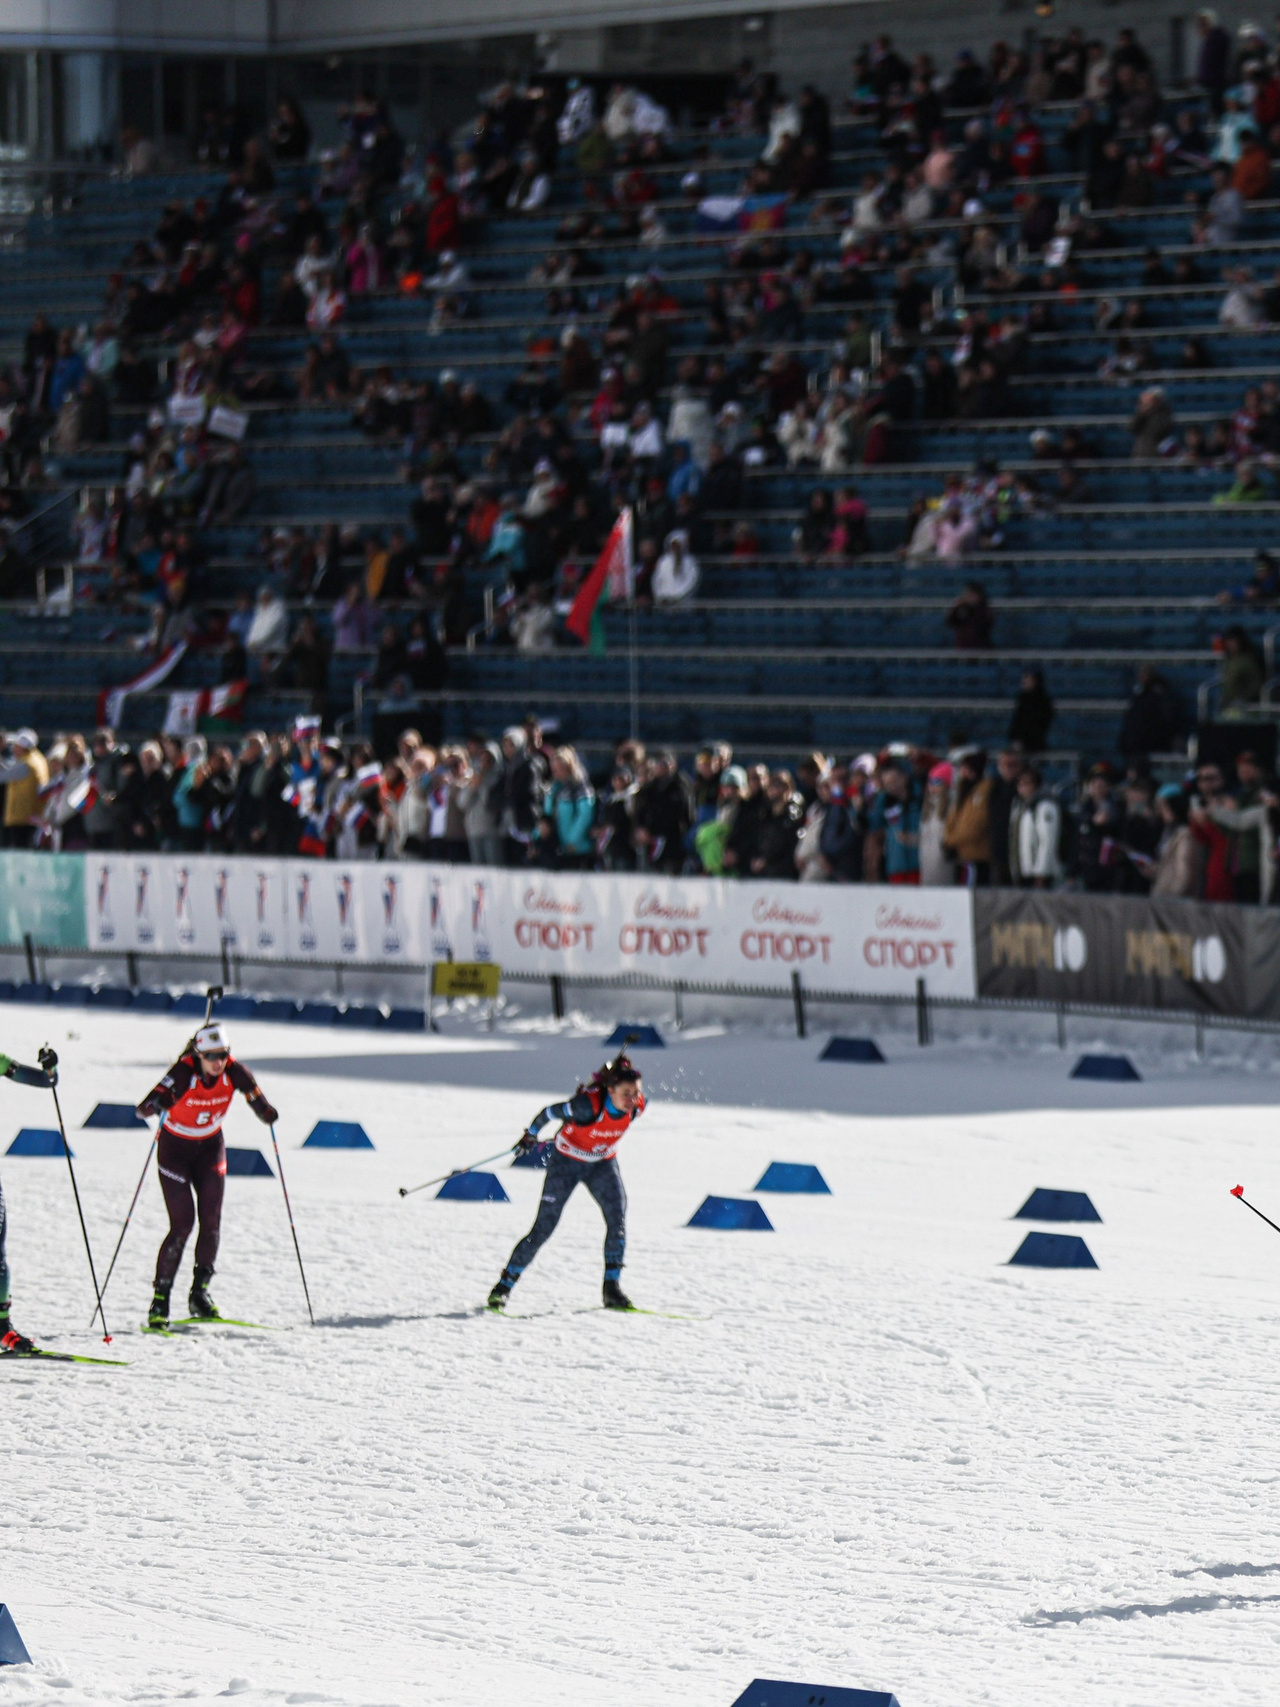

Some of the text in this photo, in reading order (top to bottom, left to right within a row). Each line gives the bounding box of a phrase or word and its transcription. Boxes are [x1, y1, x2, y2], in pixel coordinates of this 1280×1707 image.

[619, 924, 709, 957] СПОРТ
[740, 929, 831, 963] СПОРТ
[863, 936, 955, 969] СПОРТ
